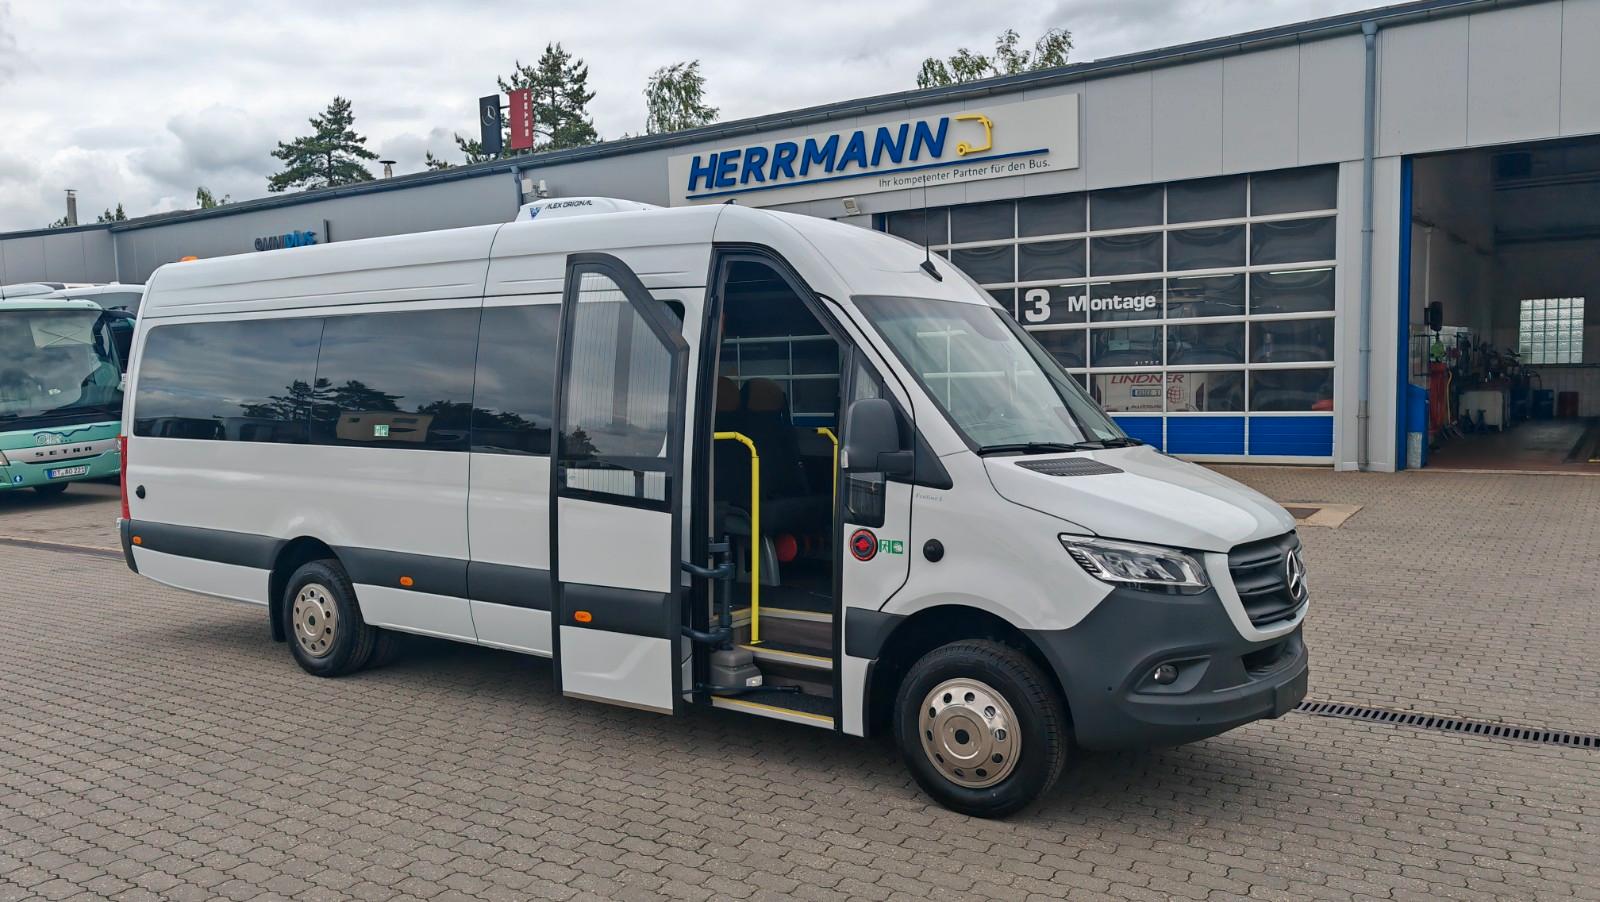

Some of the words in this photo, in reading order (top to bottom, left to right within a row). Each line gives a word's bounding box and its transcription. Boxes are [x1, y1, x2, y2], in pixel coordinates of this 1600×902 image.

[687, 116, 950, 191] HERRMANN
[879, 178, 891, 188] Ihr
[893, 172, 950, 186] kompetenter
[953, 168, 988, 179] Partner
[990, 164, 1005, 174] für
[1007, 161, 1026, 172] den
[1029, 159, 1051, 169] Bus.
[1025, 288, 1051, 322] 3
[1068, 295, 1156, 312] Montage
[36, 446, 92, 456] SETRA
